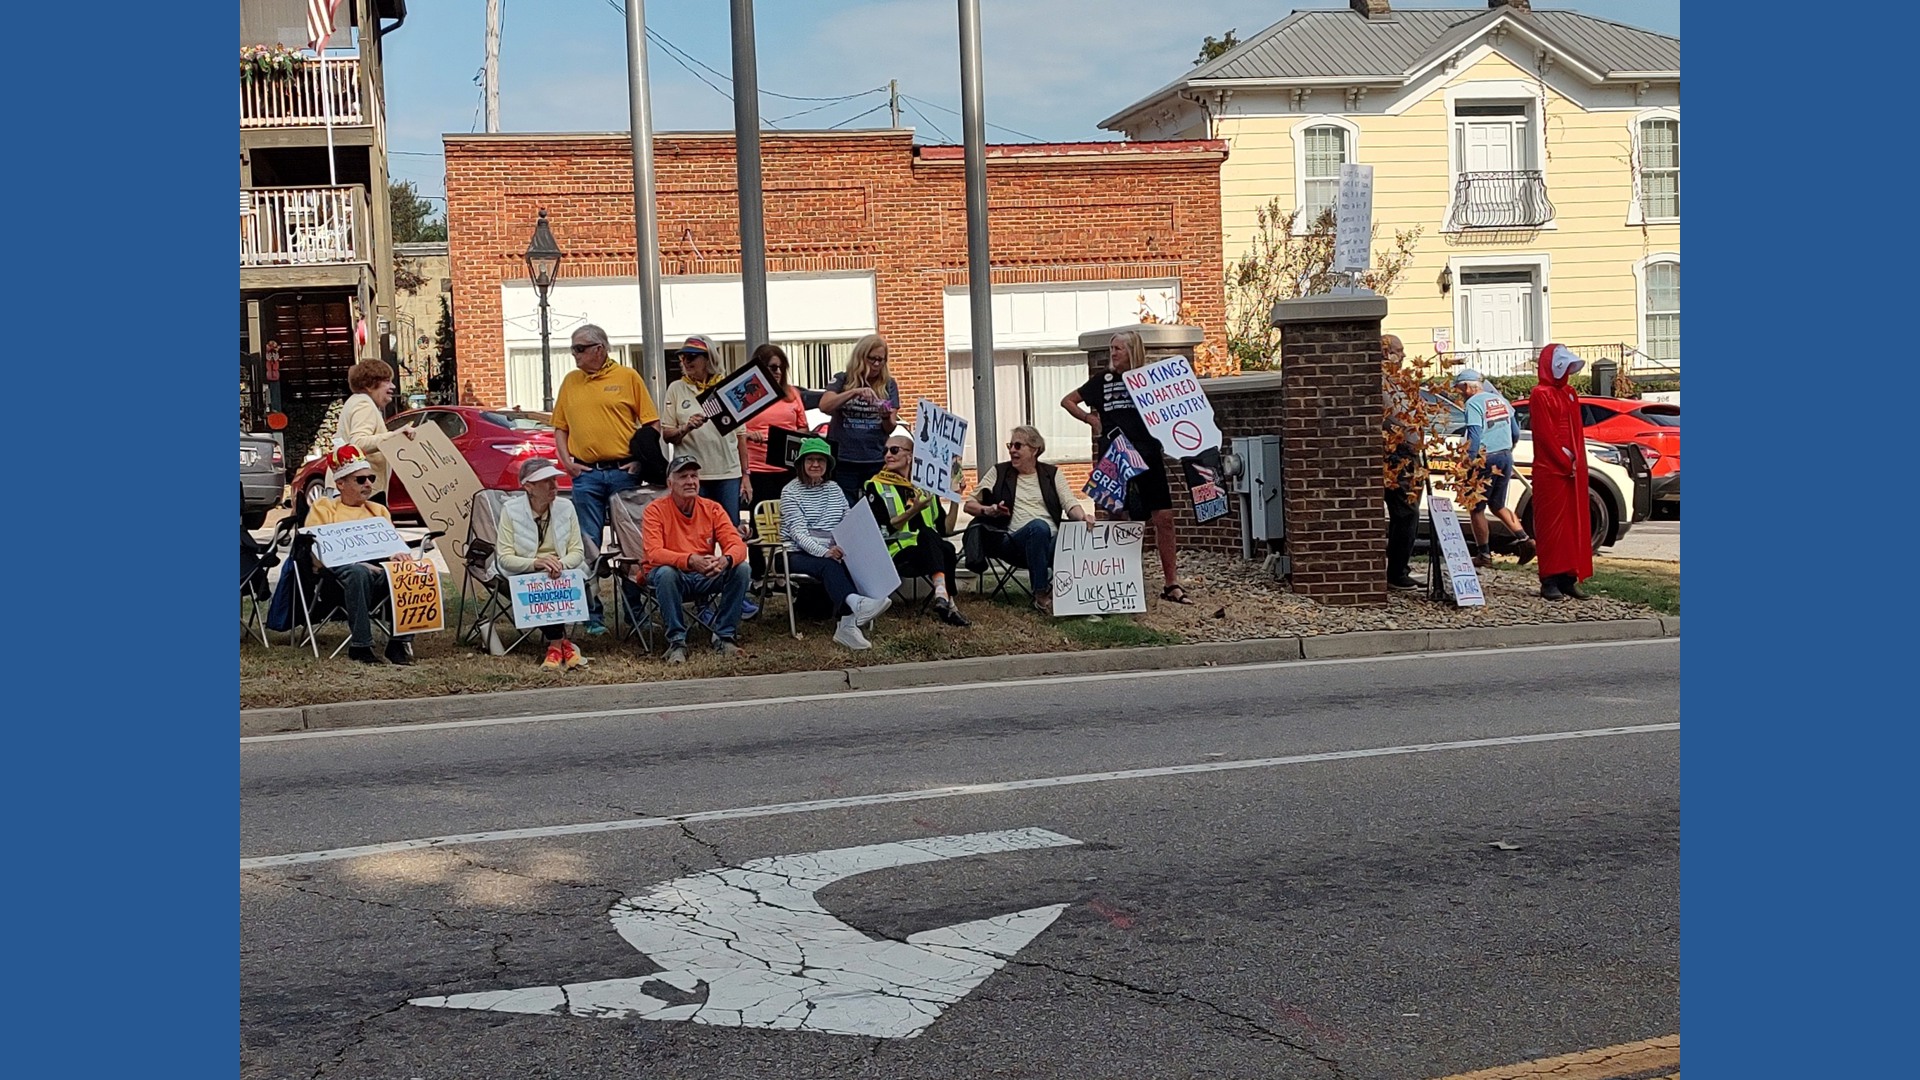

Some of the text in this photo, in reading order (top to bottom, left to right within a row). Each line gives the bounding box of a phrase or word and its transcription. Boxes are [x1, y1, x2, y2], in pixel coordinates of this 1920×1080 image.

[1126, 373, 1147, 391] NO
[1147, 361, 1189, 384] KINGS
[1136, 392, 1154, 409] NO
[1152, 379, 1196, 403] HATRED
[1144, 411, 1160, 427] NO
[1160, 394, 1207, 422] BIGOTRY
[932, 408, 967, 446] MELT
[397, 440, 457, 478] So Many
[1105, 444, 1136, 481] HATE
[913, 457, 948, 492] ICE
[1092, 469, 1123, 498] GREA
[422, 479, 458, 503] Wrongs
[430, 511, 454, 532] So
[336, 534, 368, 552] YOUR
[369, 529, 399, 544] JOB
[1062, 524, 1110, 552] LIVE!
[393, 562, 412, 573] No
[394, 572, 435, 591] Kings
[527, 579, 571, 592] THIS IS WHAT
[1107, 581, 1138, 598] HIM
[397, 588, 436, 607] Since
[528, 589, 573, 603] DEMOCRACY
[530, 601, 575, 614] LOOKS LIKE
[1097, 597, 1136, 611] UP!!!
[400, 602, 437, 626] 1776
